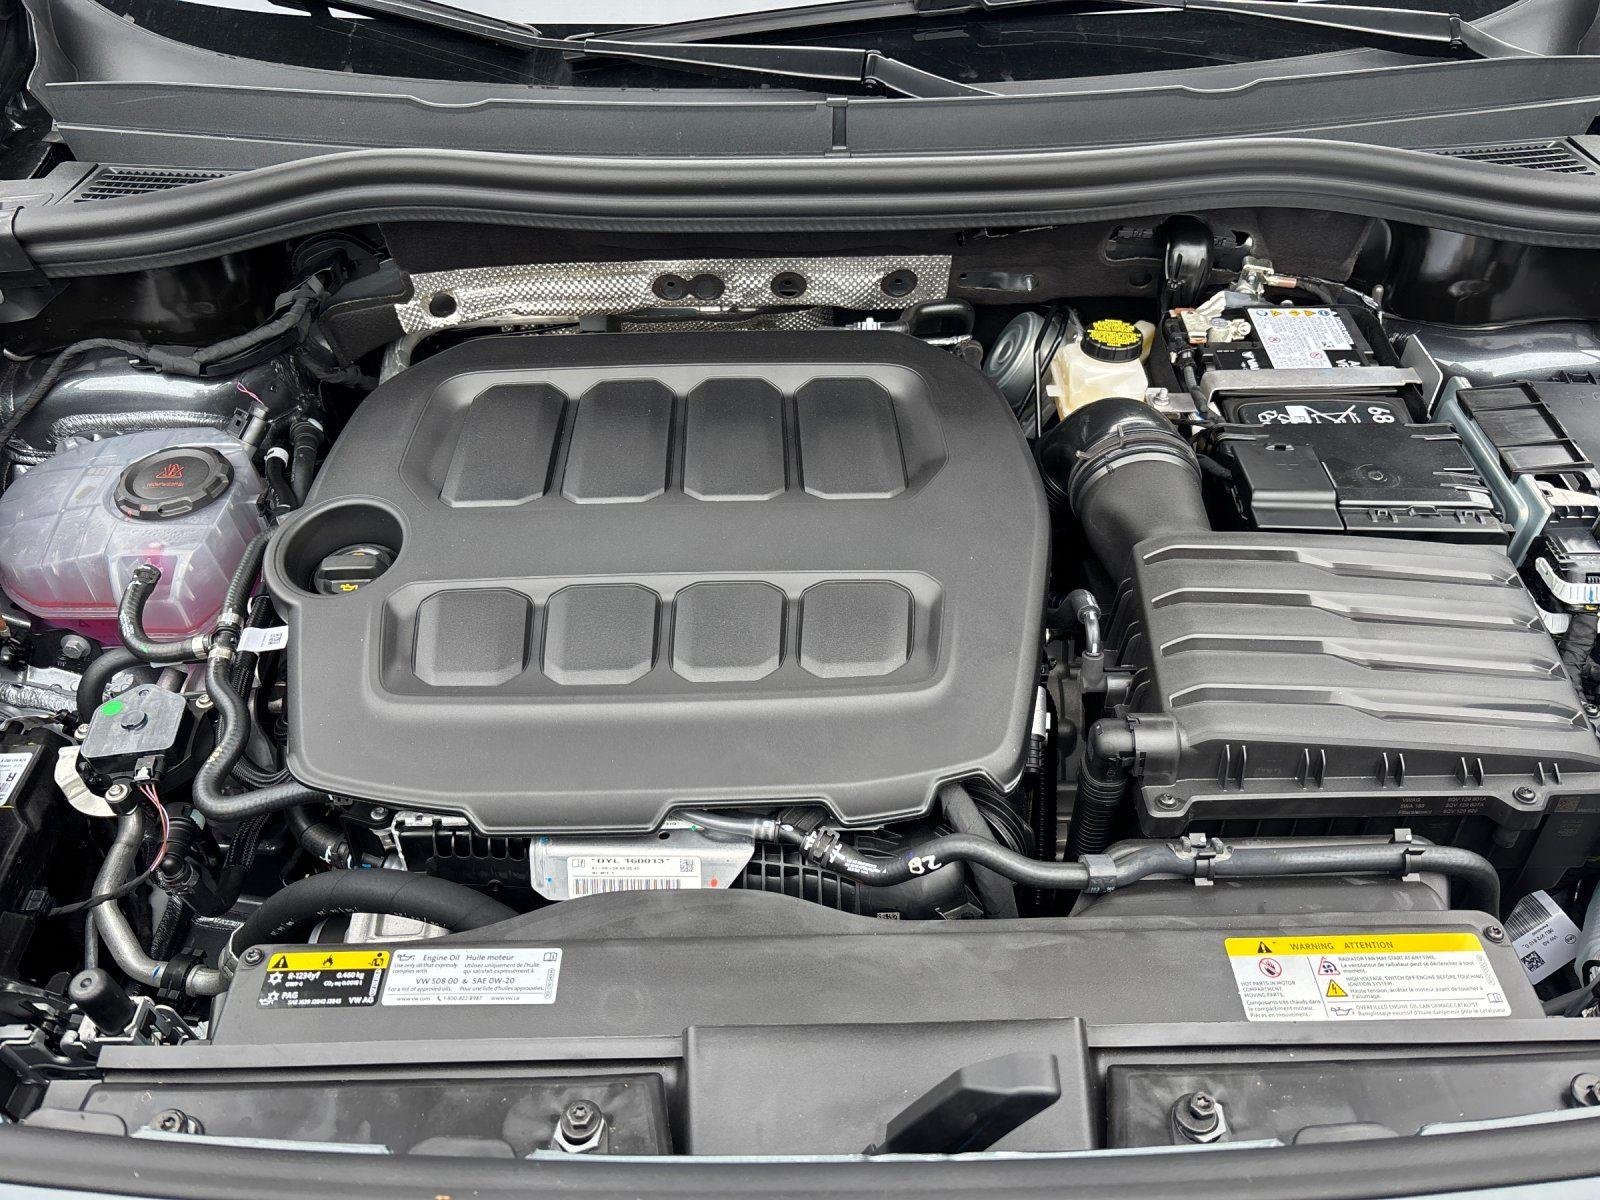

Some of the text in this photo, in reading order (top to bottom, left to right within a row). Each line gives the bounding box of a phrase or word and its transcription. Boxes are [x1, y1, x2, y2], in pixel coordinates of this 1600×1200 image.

[287, 972, 321, 981] R-1234yf
[357, 972, 365, 980] kg
[281, 991, 299, 1000] PAG
